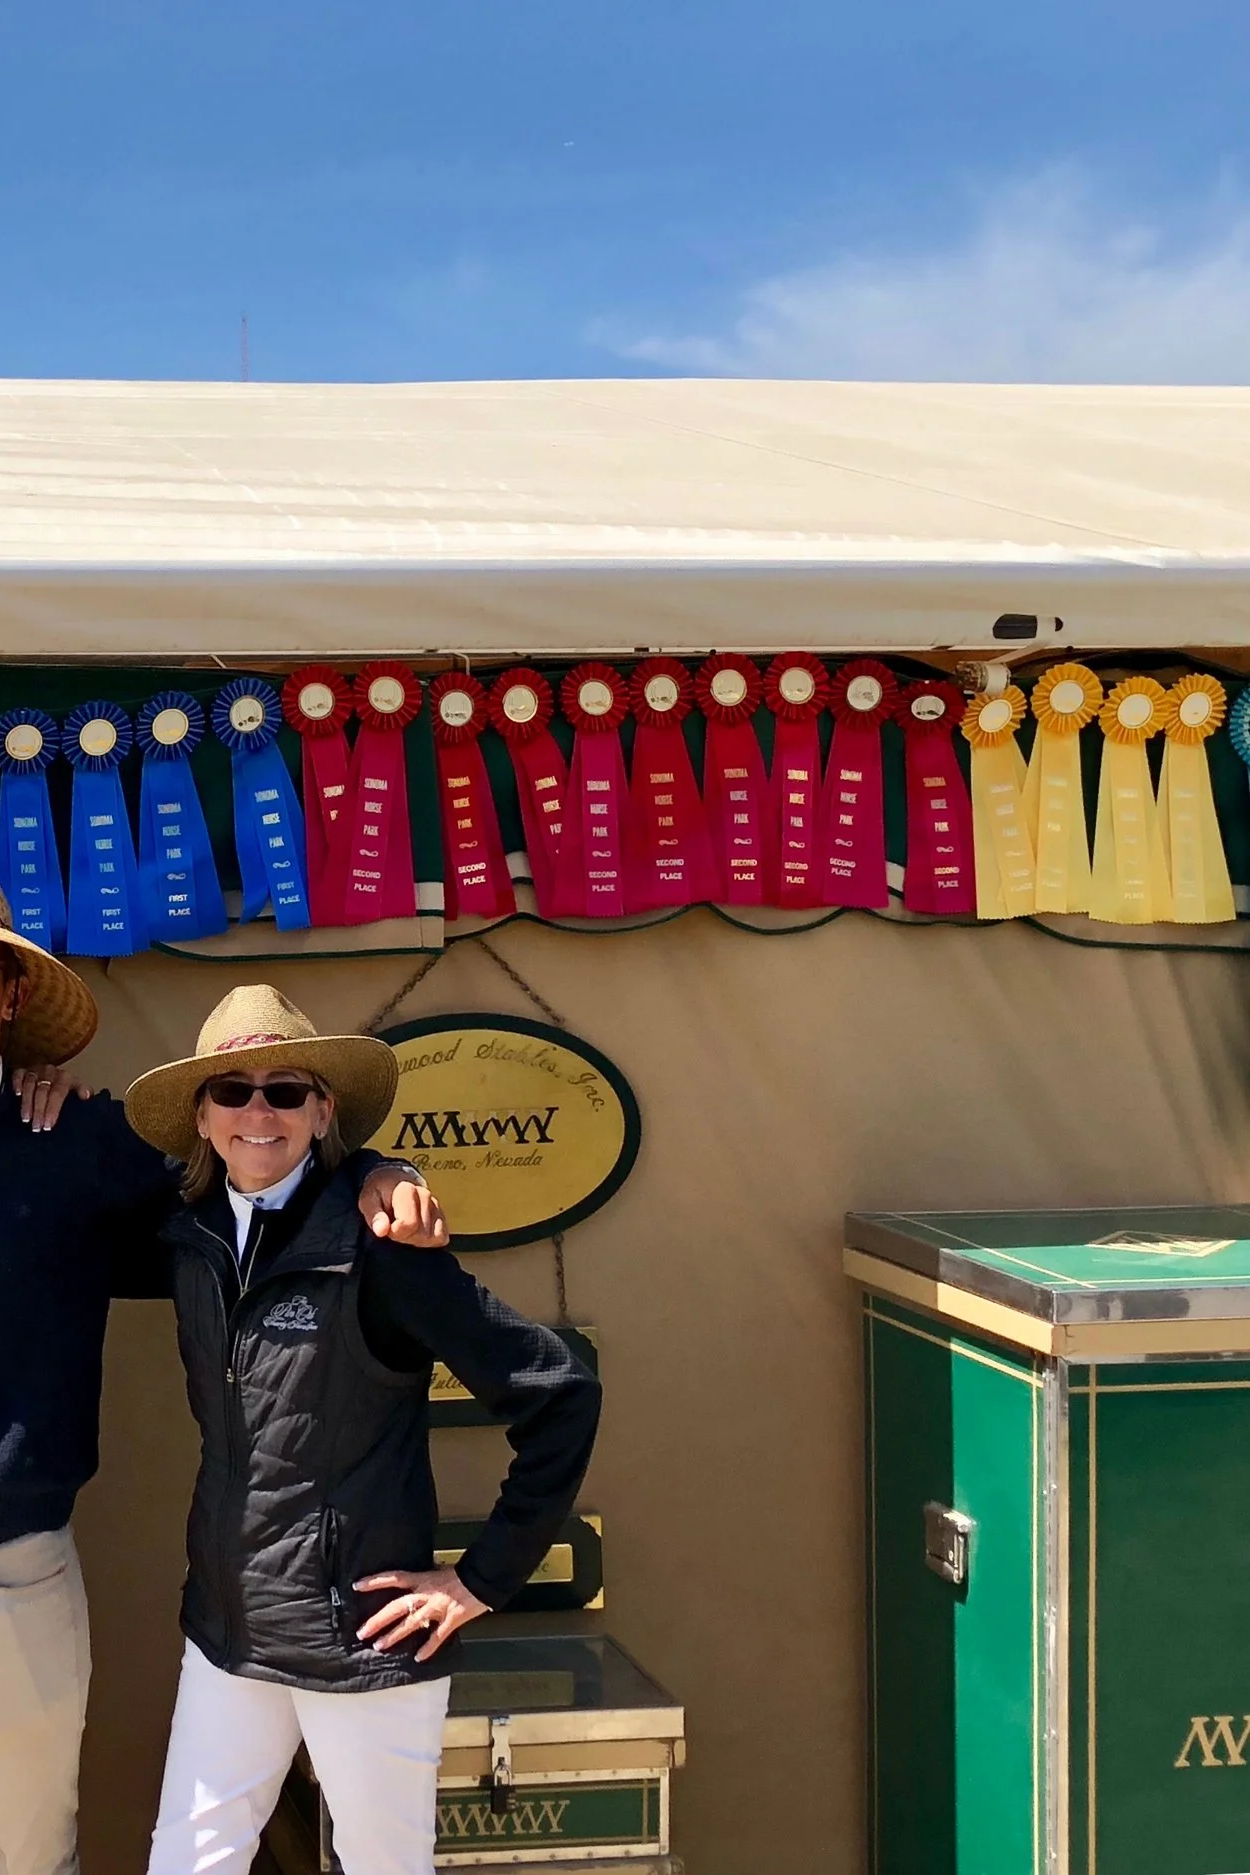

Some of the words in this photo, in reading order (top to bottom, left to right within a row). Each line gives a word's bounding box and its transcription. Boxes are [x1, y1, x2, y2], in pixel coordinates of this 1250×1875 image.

[567, 1071, 606, 1112] Inc.
[411, 1154, 466, 1171] Reno,
[475, 1149, 542, 1168] Nevada
